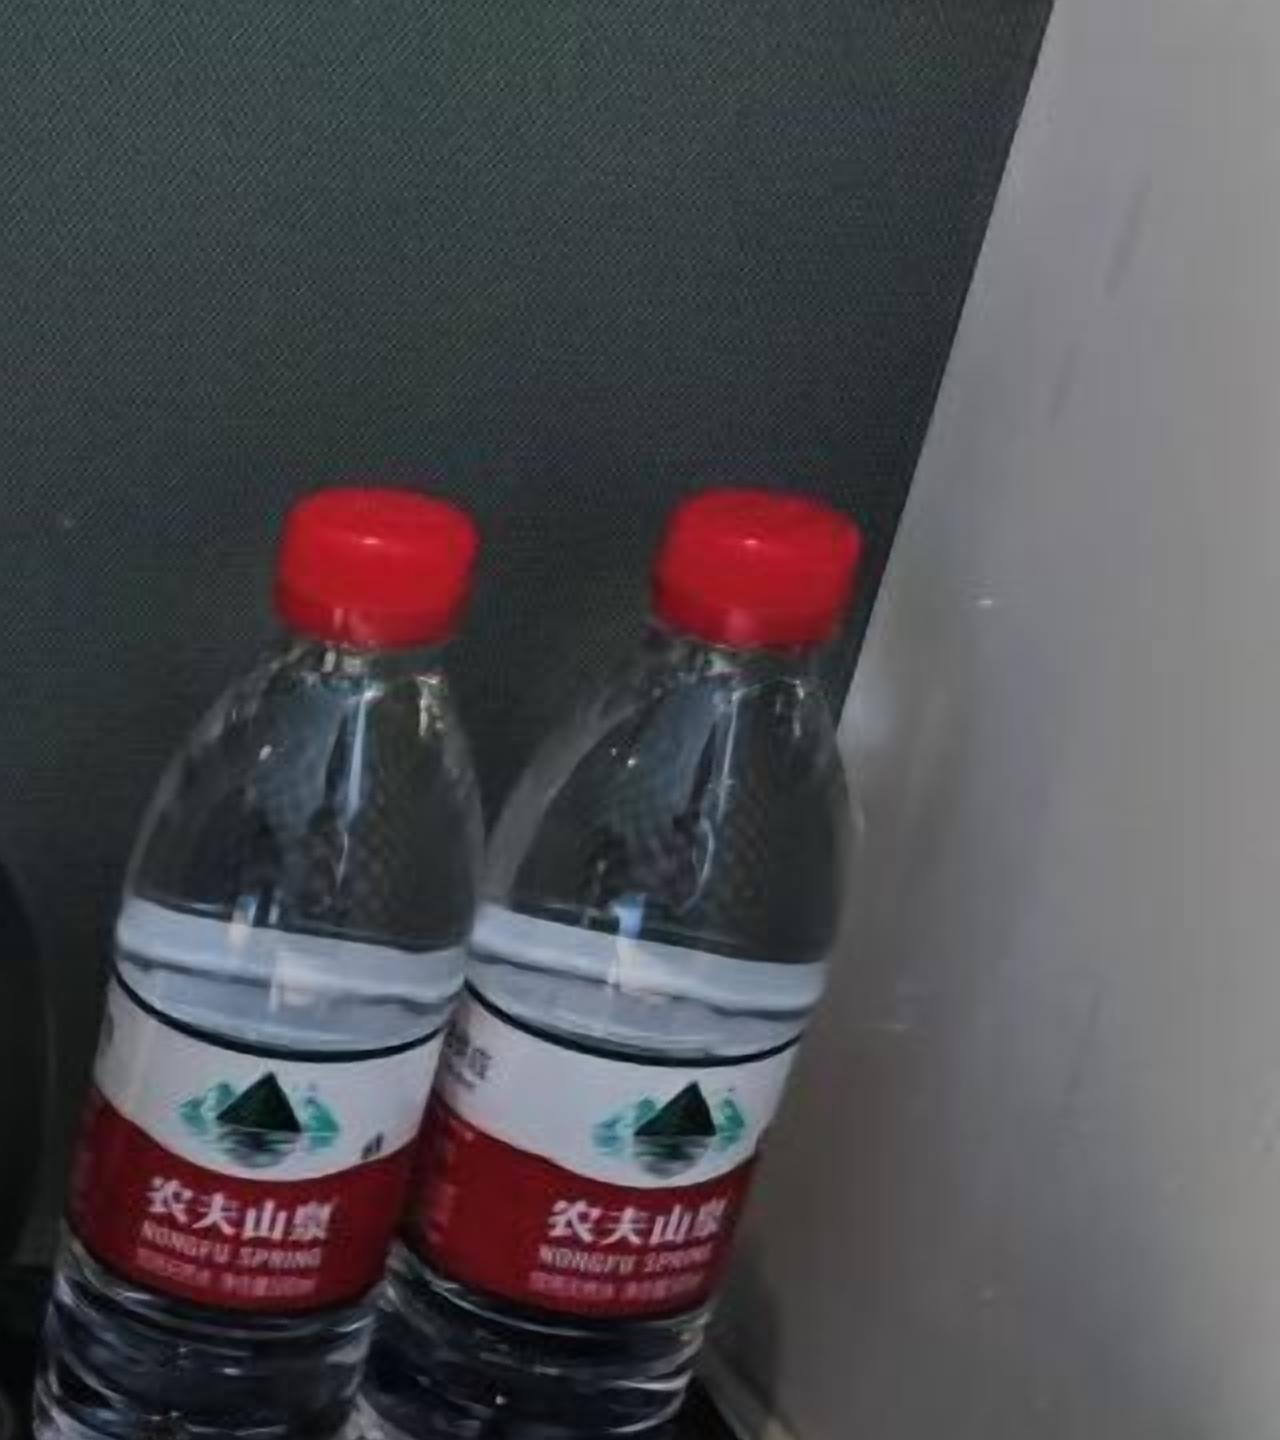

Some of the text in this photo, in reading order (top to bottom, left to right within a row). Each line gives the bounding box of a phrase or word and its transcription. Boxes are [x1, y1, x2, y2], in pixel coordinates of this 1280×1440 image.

[145, 1175, 336, 1242] 农夫山泉
[547, 1198, 728, 1245] 农夫山泉
[140, 1220, 323, 1270] NONGFU SPRING
[538, 1244, 637, 1275] NONGFU
